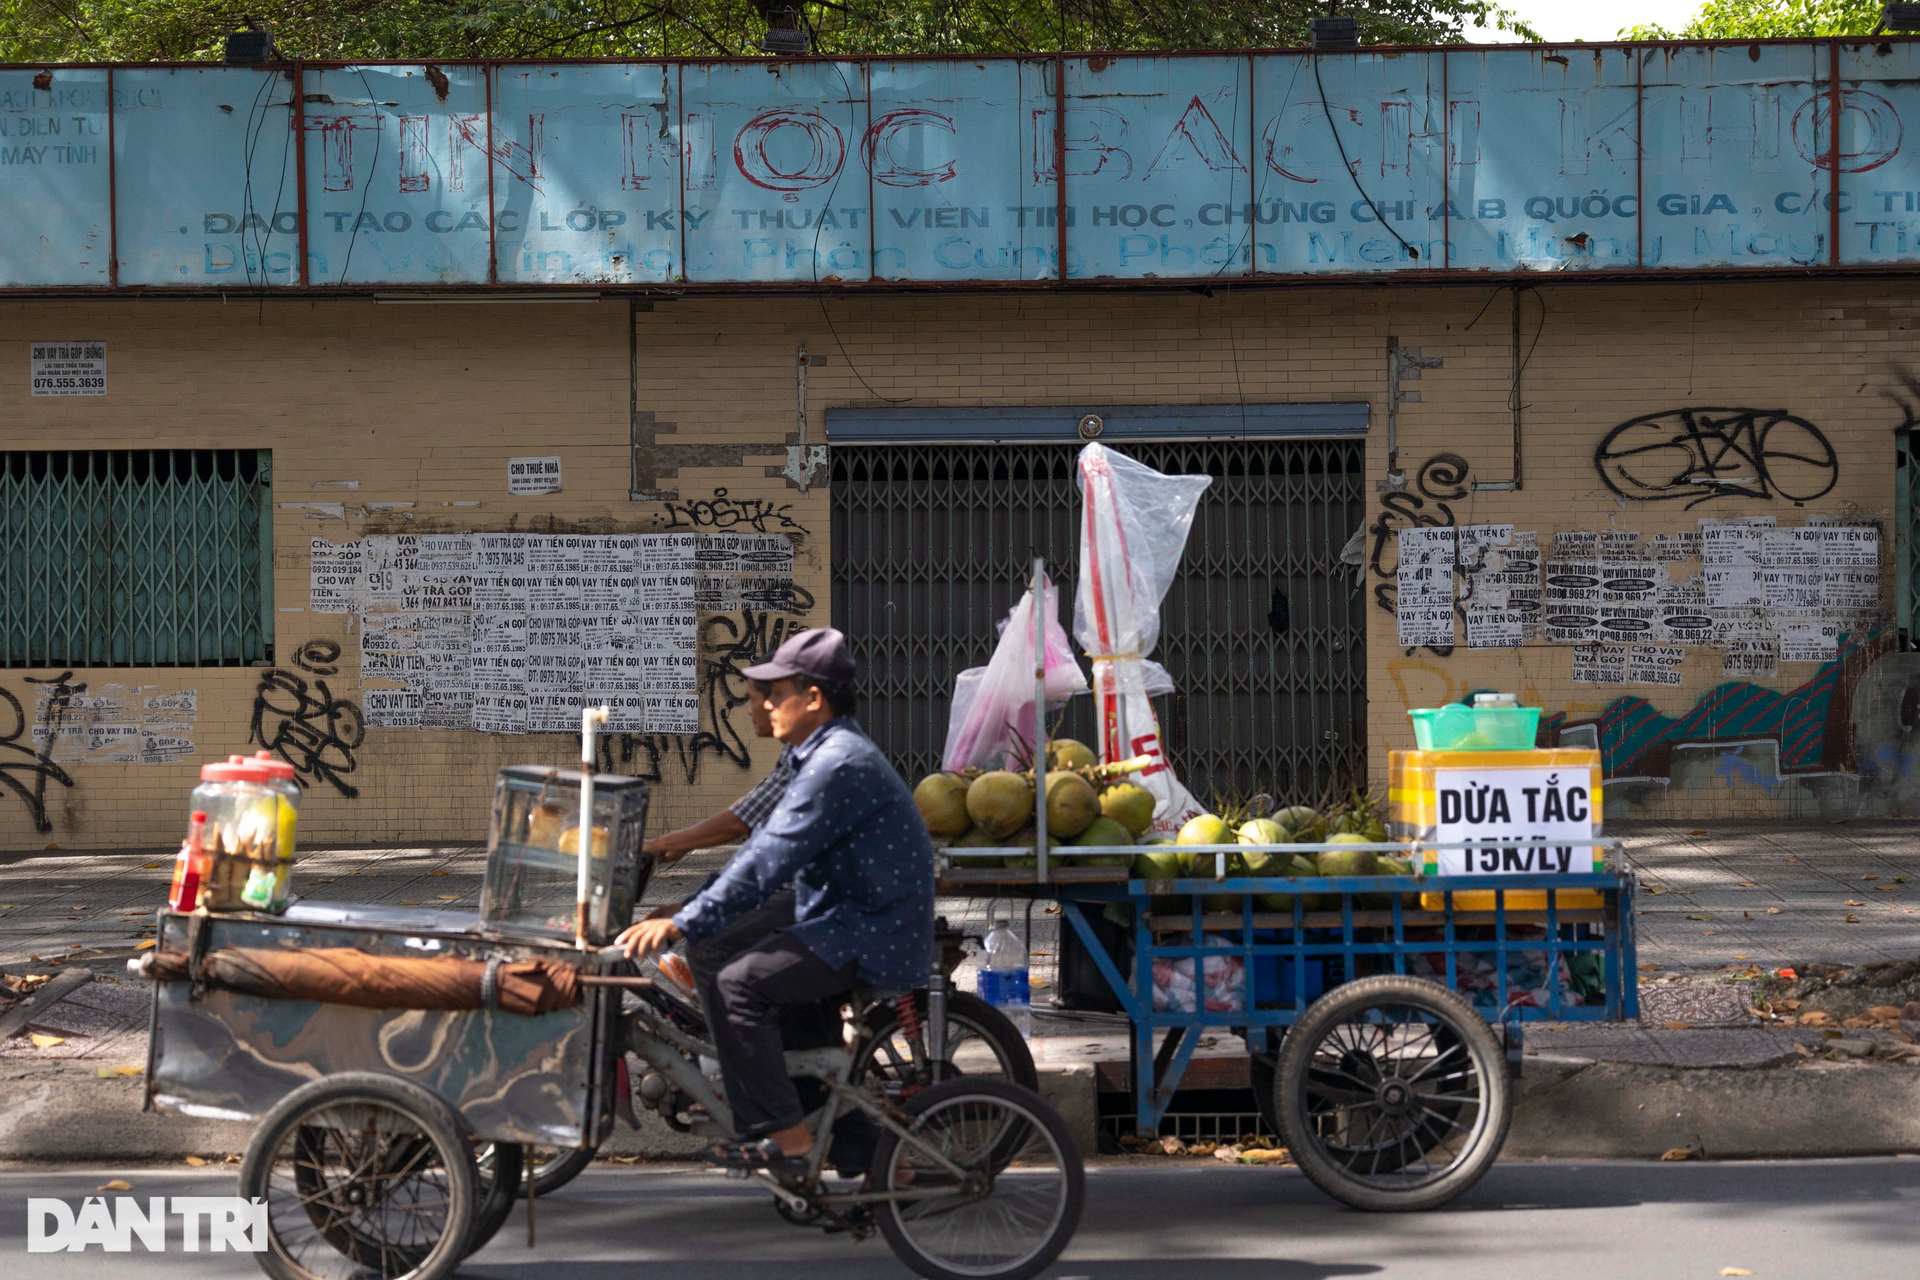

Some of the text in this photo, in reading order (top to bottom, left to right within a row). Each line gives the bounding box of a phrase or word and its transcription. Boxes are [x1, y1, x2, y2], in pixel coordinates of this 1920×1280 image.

[1, 141, 97, 165] MÁY TÍNH
[291, 114, 546, 198] TIN
[621, 107, 957, 203] HỌC
[323, 210, 413, 235] TẠO
[424, 203, 520, 233] CÁC
[540, 200, 627, 232] LỚP
[731, 203, 867, 231] THUẬT
[886, 201, 990, 229] VIÊN
[1005, 206, 1077, 229] TIN
[1524, 188, 1638, 223] QUỐC
[1774, 188, 1853, 216] C/C
[33, 347, 46, 360] CHO
[47, 347, 57, 359] VAY
[70, 344, 82, 360] GÓP
[34, 378, 105, 388] 076.555.3639
[511, 460, 559, 475] CHO THUÊ NHÀ
[486, 537, 499, 549] VAY
[513, 535, 525, 549] GÓP
[727, 535, 740, 550] GÓP
[317, 576, 356, 585] CHO VAY
[448, 586, 473, 596] GÓP
[529, 614, 580, 629] CHO VAY TRẢ GÓP
[540, 632, 556, 646] 0975
[556, 632, 568, 645] 704
[569, 632, 580, 645] 345
[1602, 646, 1625, 654] VAY
[1631, 645, 1683, 656] CHO VAY
[528, 652, 580, 668] CHO VAY TRẢ GÓP
[1600, 653, 1625, 664] GÓP
[1657, 656, 1682, 666] GÓP
[425, 692, 458, 701] CHO VAY
[393, 718, 407, 726] 019
[88, 727, 105, 735] CHO
[106, 727, 121, 735] VAY
[1440, 773, 1588, 825] DỪA TẮC
